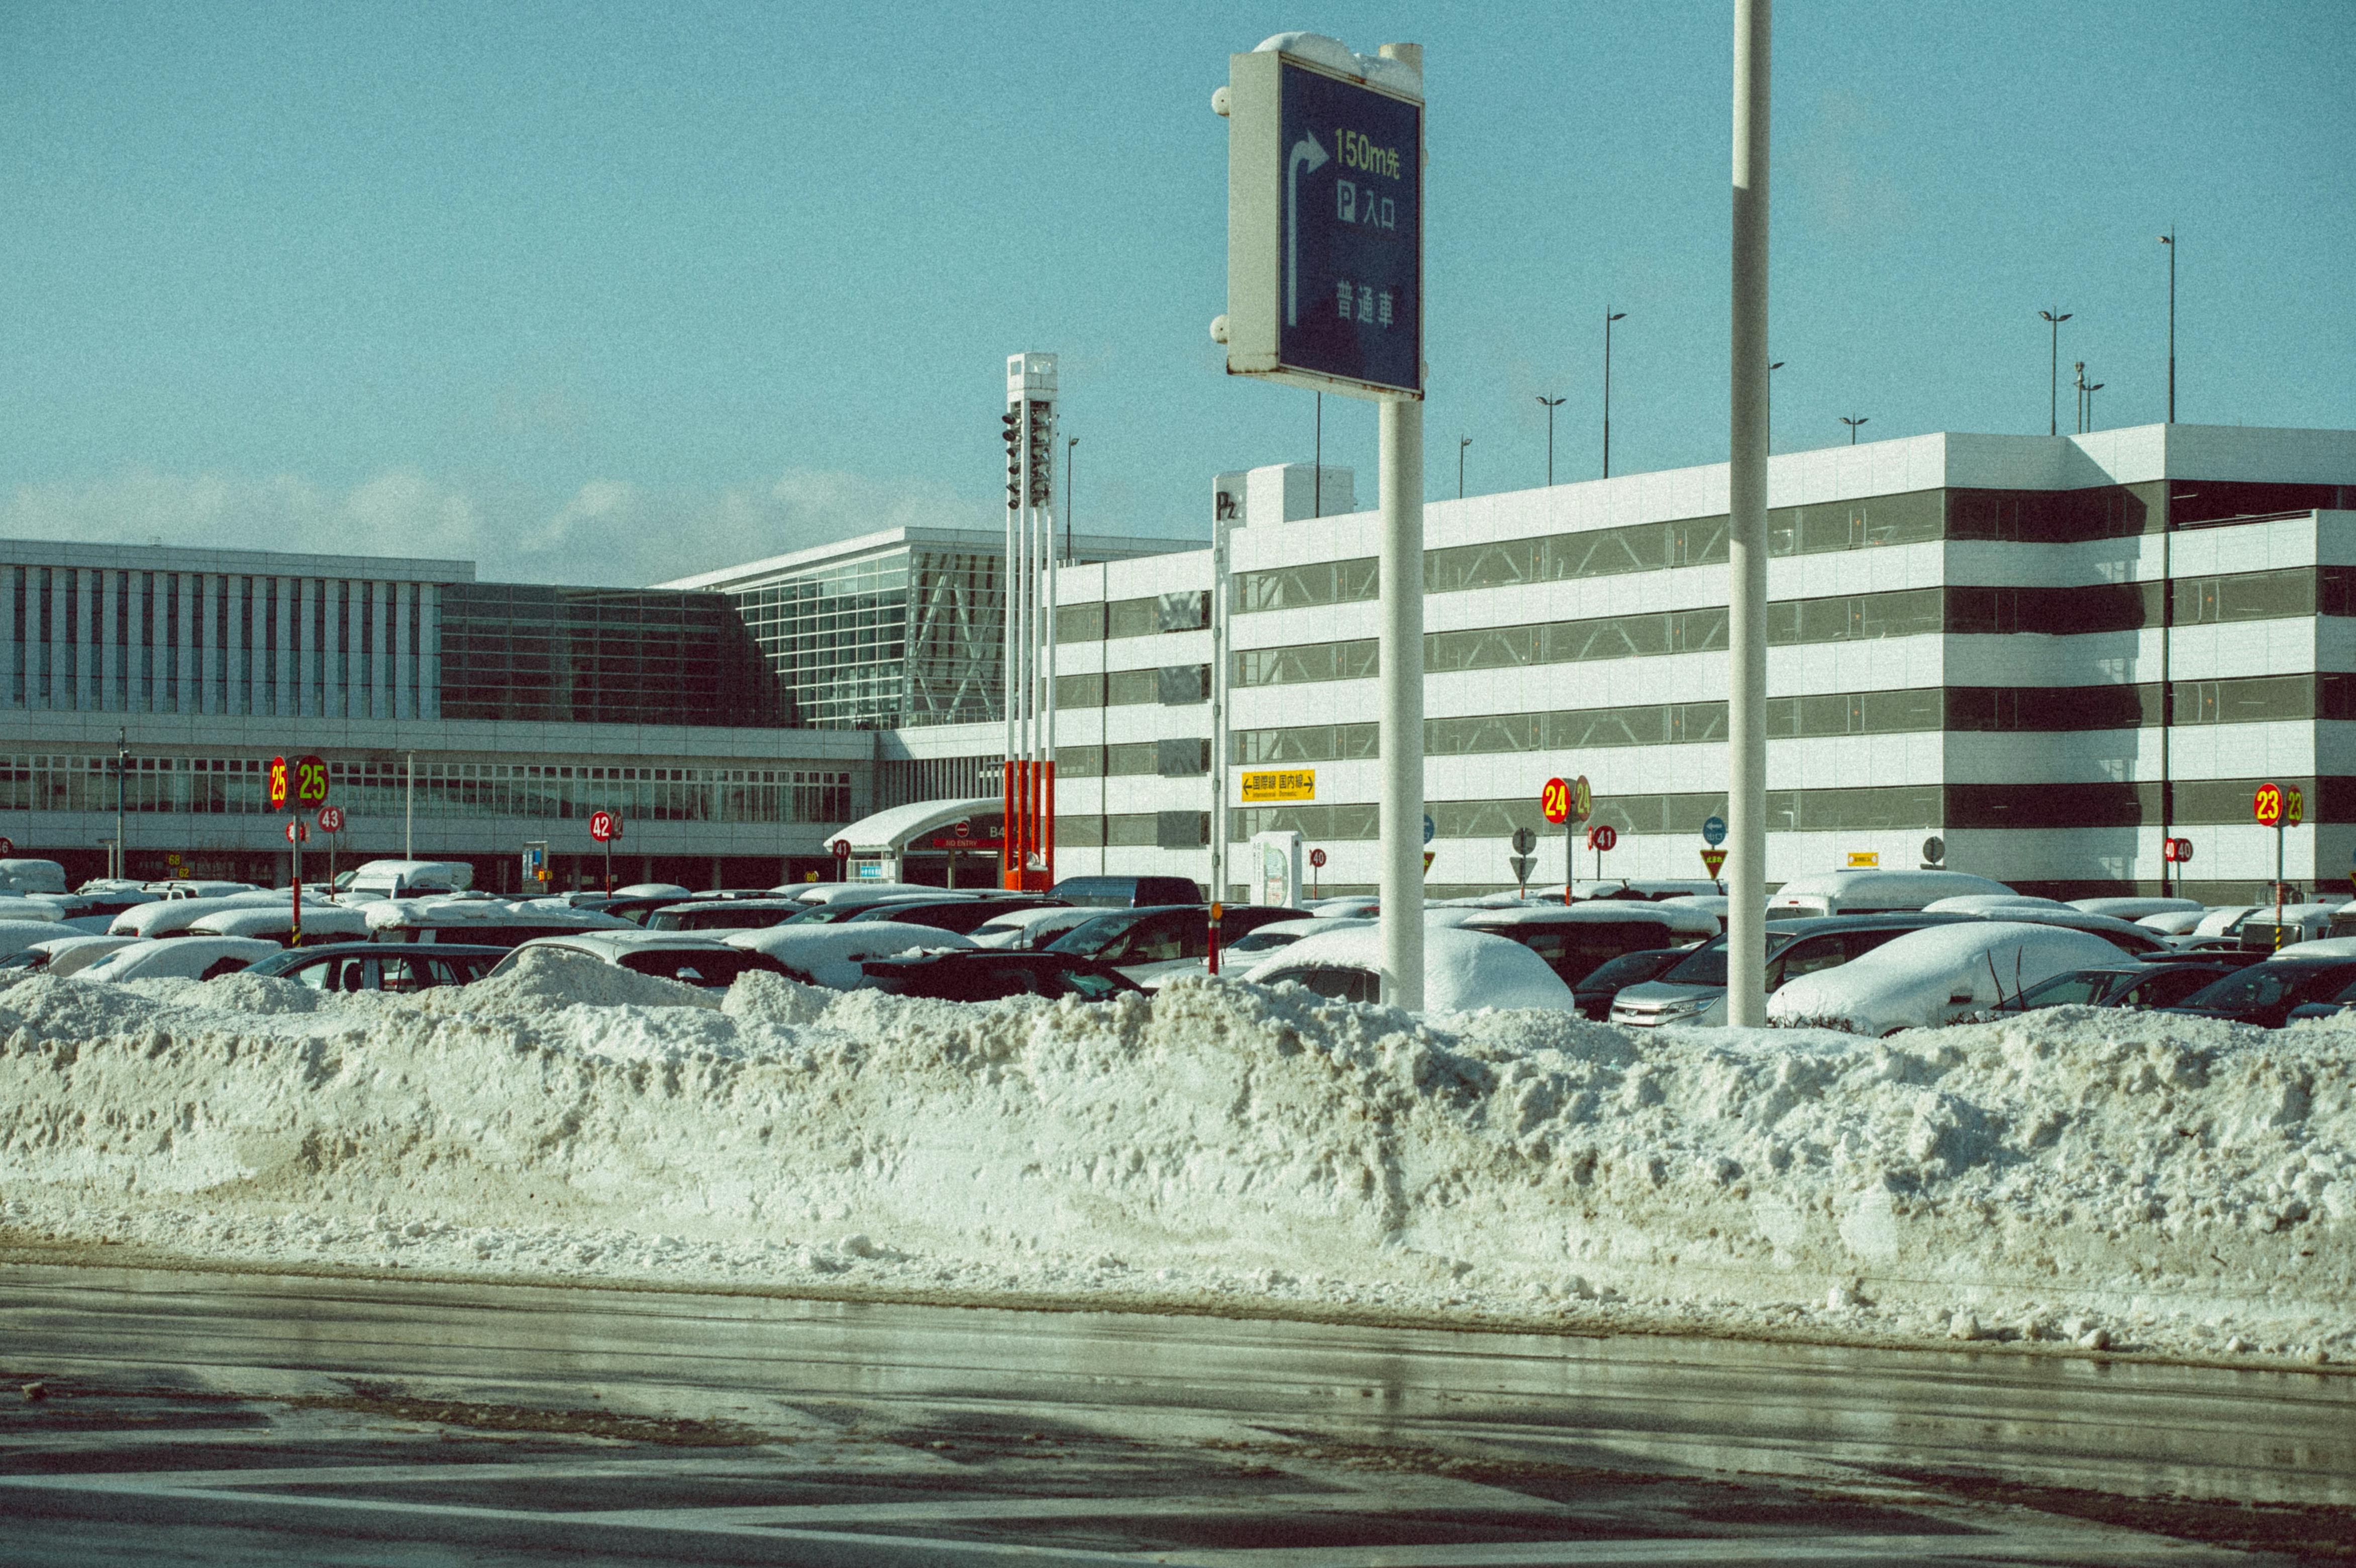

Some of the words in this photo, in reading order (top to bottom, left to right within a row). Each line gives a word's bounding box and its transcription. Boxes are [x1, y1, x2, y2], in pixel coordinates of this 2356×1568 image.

[1335, 128, 1400, 180] 150m先
[1364, 190, 1395, 231] 入口
[1337, 279, 1394, 328] 普通車
[272, 765, 285, 800] 25
[299, 764, 325, 799] 25
[1279, 774, 1302, 789] 国内線
[1546, 785, 1566, 816] 24
[1578, 783, 1590, 813] 24
[2257, 790, 2279, 819] 23
[2289, 791, 2301, 820] 23
[322, 810, 339, 827] 43
[593, 816, 609, 837] 42
[1598, 830, 1611, 847] 41
[836, 843, 846, 856] 41
[1313, 852, 1324, 864] 40
[2166, 842, 2174, 858] 40
[2178, 843, 2191, 858] 40
[168, 855, 180, 865] 68
[179, 868, 189, 878] 62
[806, 873, 816, 882] 60
